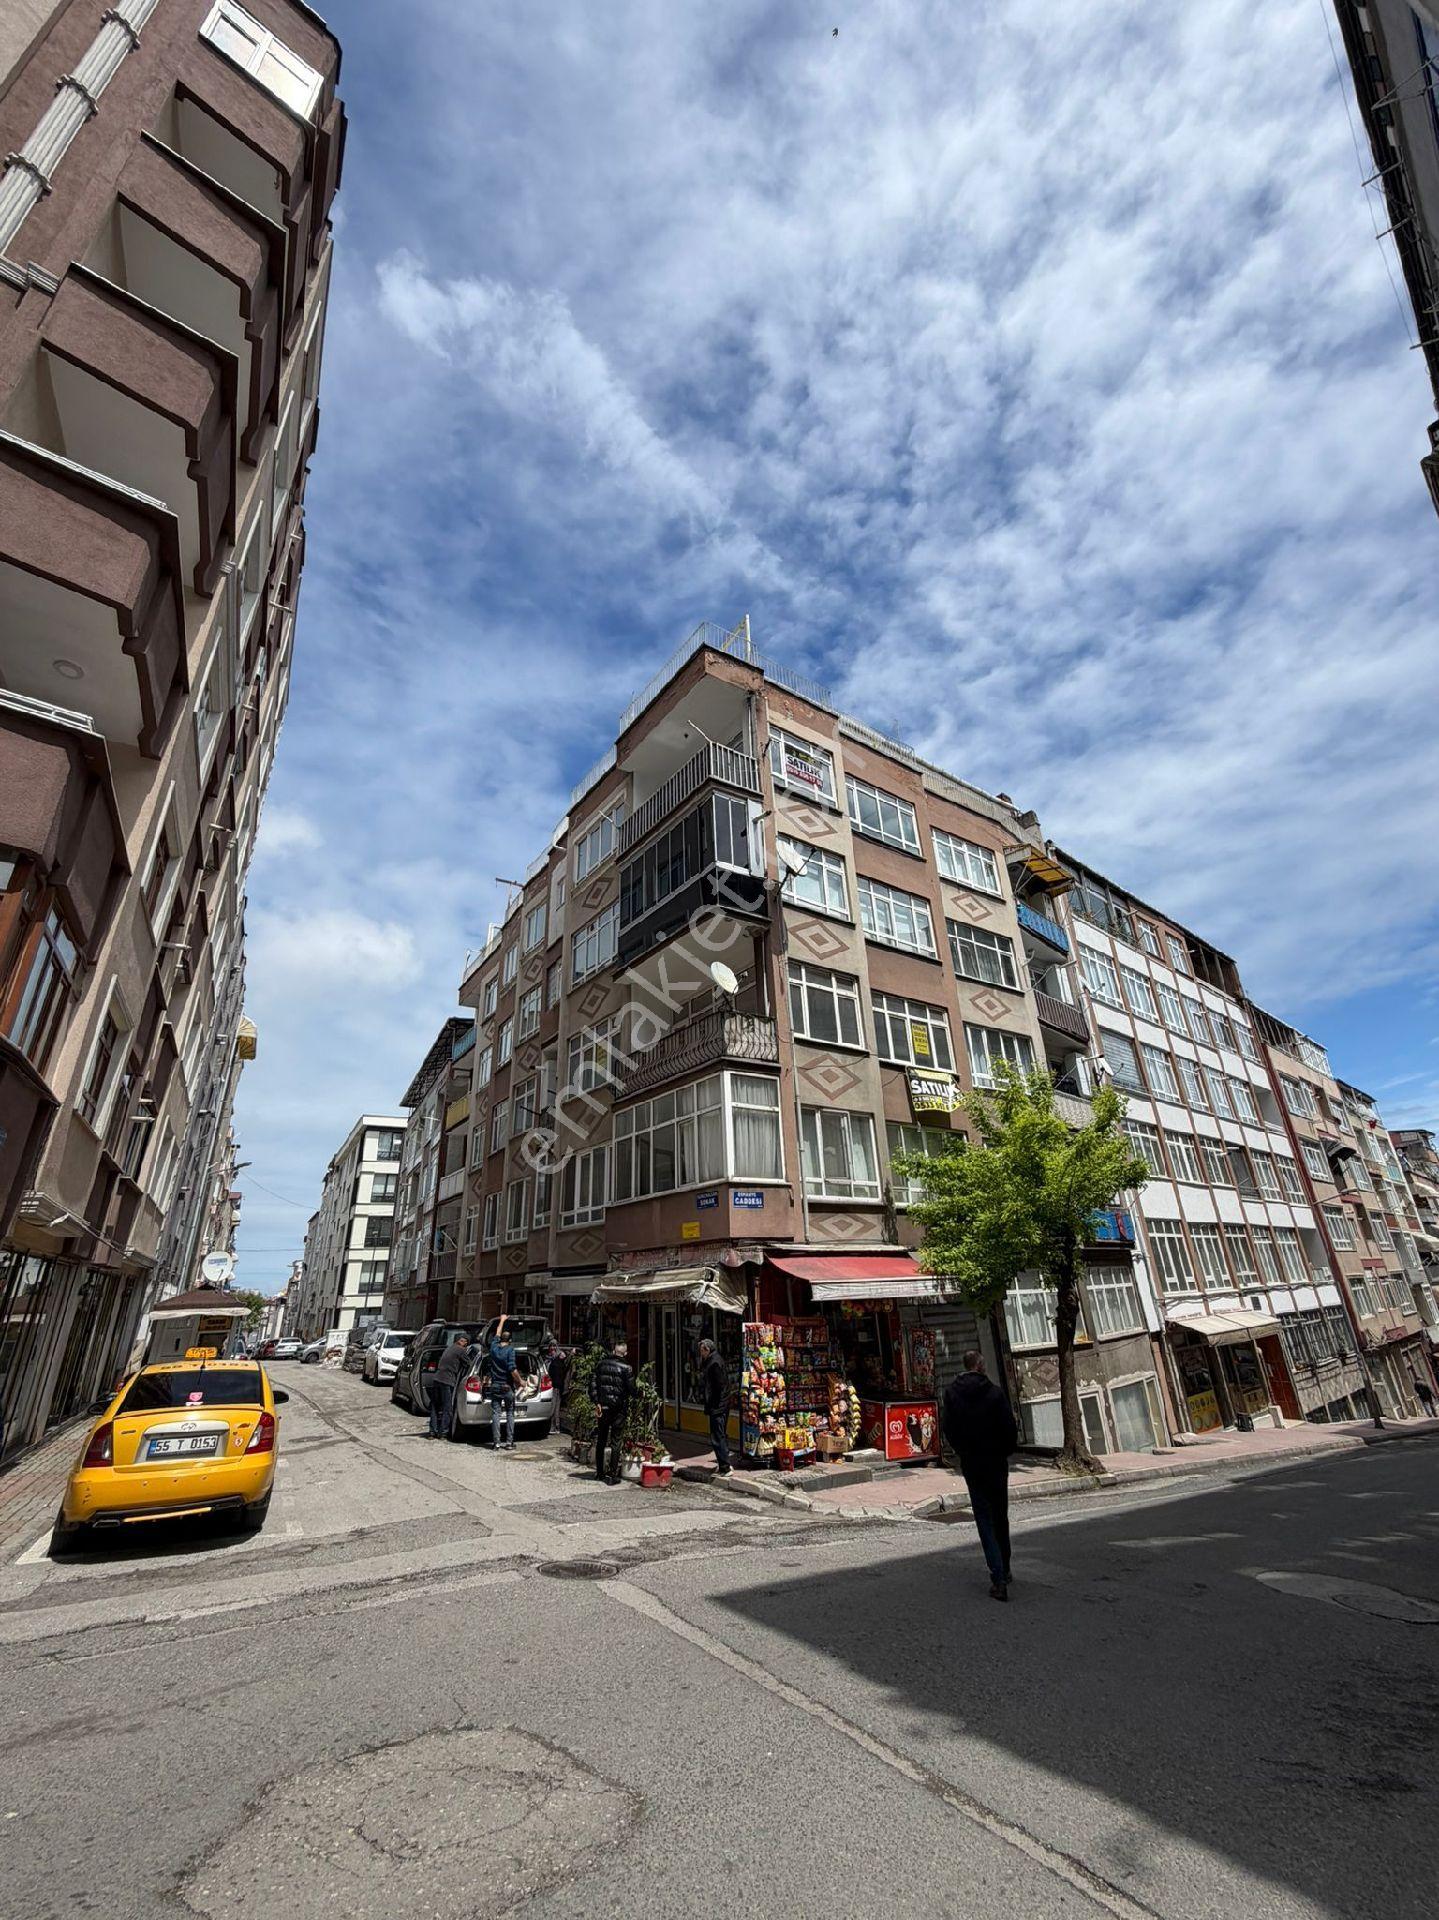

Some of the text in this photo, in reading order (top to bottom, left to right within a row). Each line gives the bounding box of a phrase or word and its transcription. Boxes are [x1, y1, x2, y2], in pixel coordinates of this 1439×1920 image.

[155, 1438, 218, 1452] 55 T 0153
